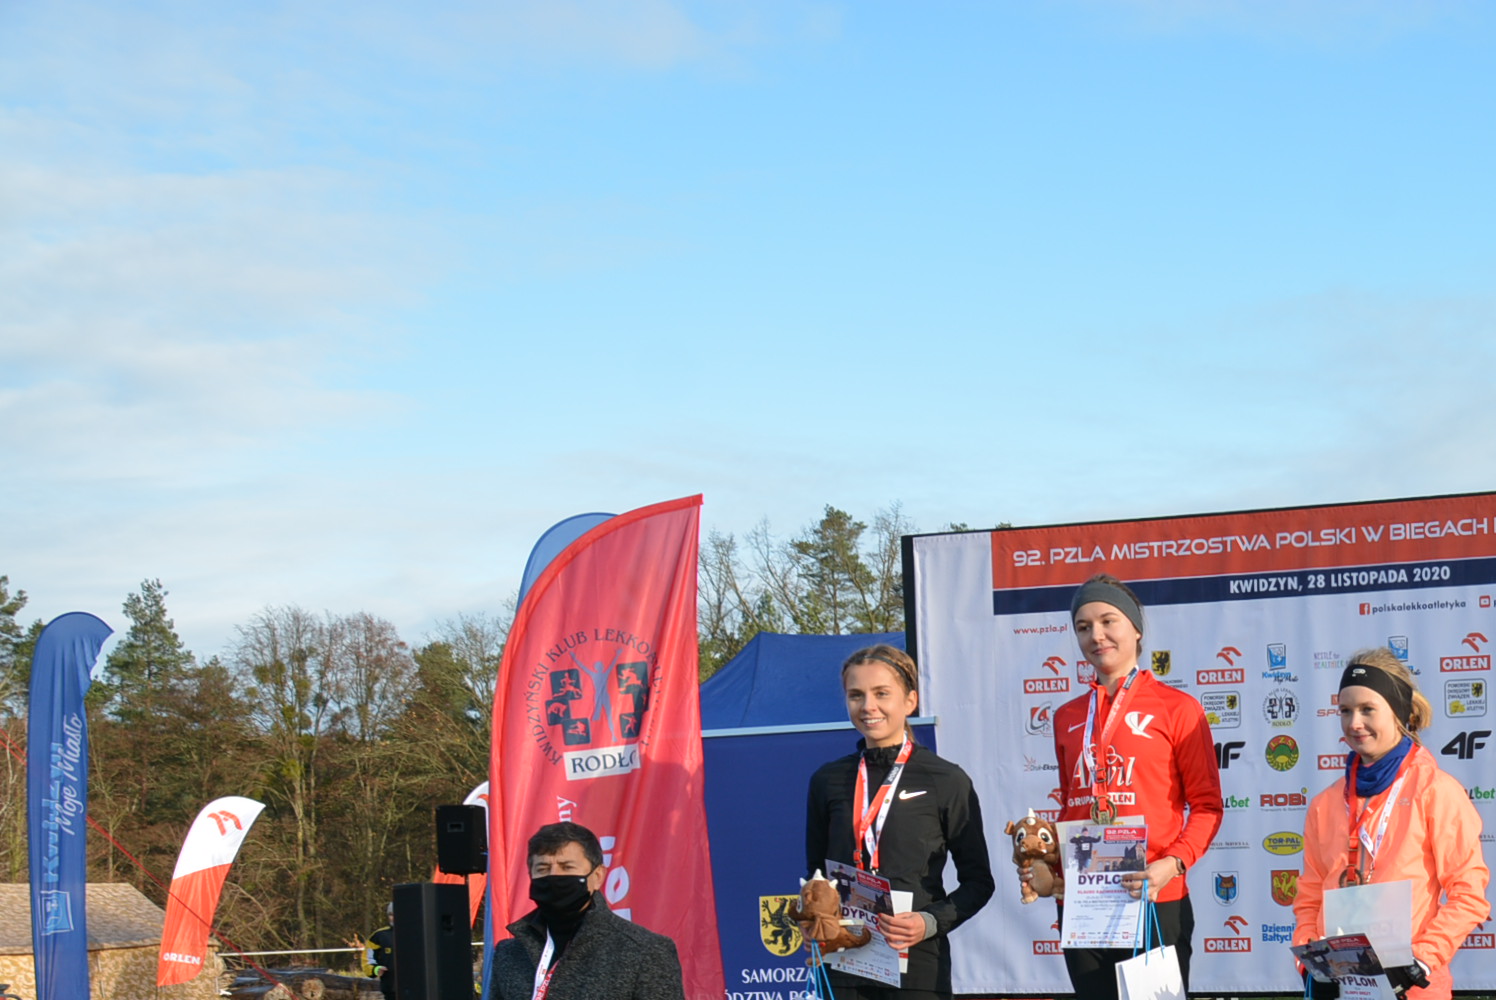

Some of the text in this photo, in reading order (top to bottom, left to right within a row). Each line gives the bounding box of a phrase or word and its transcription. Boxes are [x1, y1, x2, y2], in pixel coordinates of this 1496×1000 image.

[1013, 550, 1045, 567] 92.
[1050, 545, 1106, 564] PZLA
[1111, 534, 1271, 561] MISTRZOSTWA
[1276, 527, 1356, 548] POLSKI
[1361, 524, 1384, 542] W
[1389, 517, 1488, 541] BIEGACH
[1229, 565, 1451, 594] KWIDZYN, 28 LISTOPADA 2020
[1372, 599, 1466, 614] polskalekkoatletyka
[1013, 624, 1068, 636] www.pzla.pl
[546, 631, 588, 663] KLUB
[1442, 657, 1488, 671] ORLEN
[1199, 670, 1242, 684] ORLEN
[1025, 680, 1068, 692] ORLEN
[1441, 730, 1492, 760] 4F
[1320, 756, 1346, 769] ORL
[1068, 795, 1095, 807] GRUPA
[842, 907, 879, 925] DYPLO
[1262, 923, 1296, 934] Dzienni
[1207, 938, 1249, 951] ORLEN
[1460, 935, 1492, 947] RLEN
[163, 952, 201, 965] ORLEN
